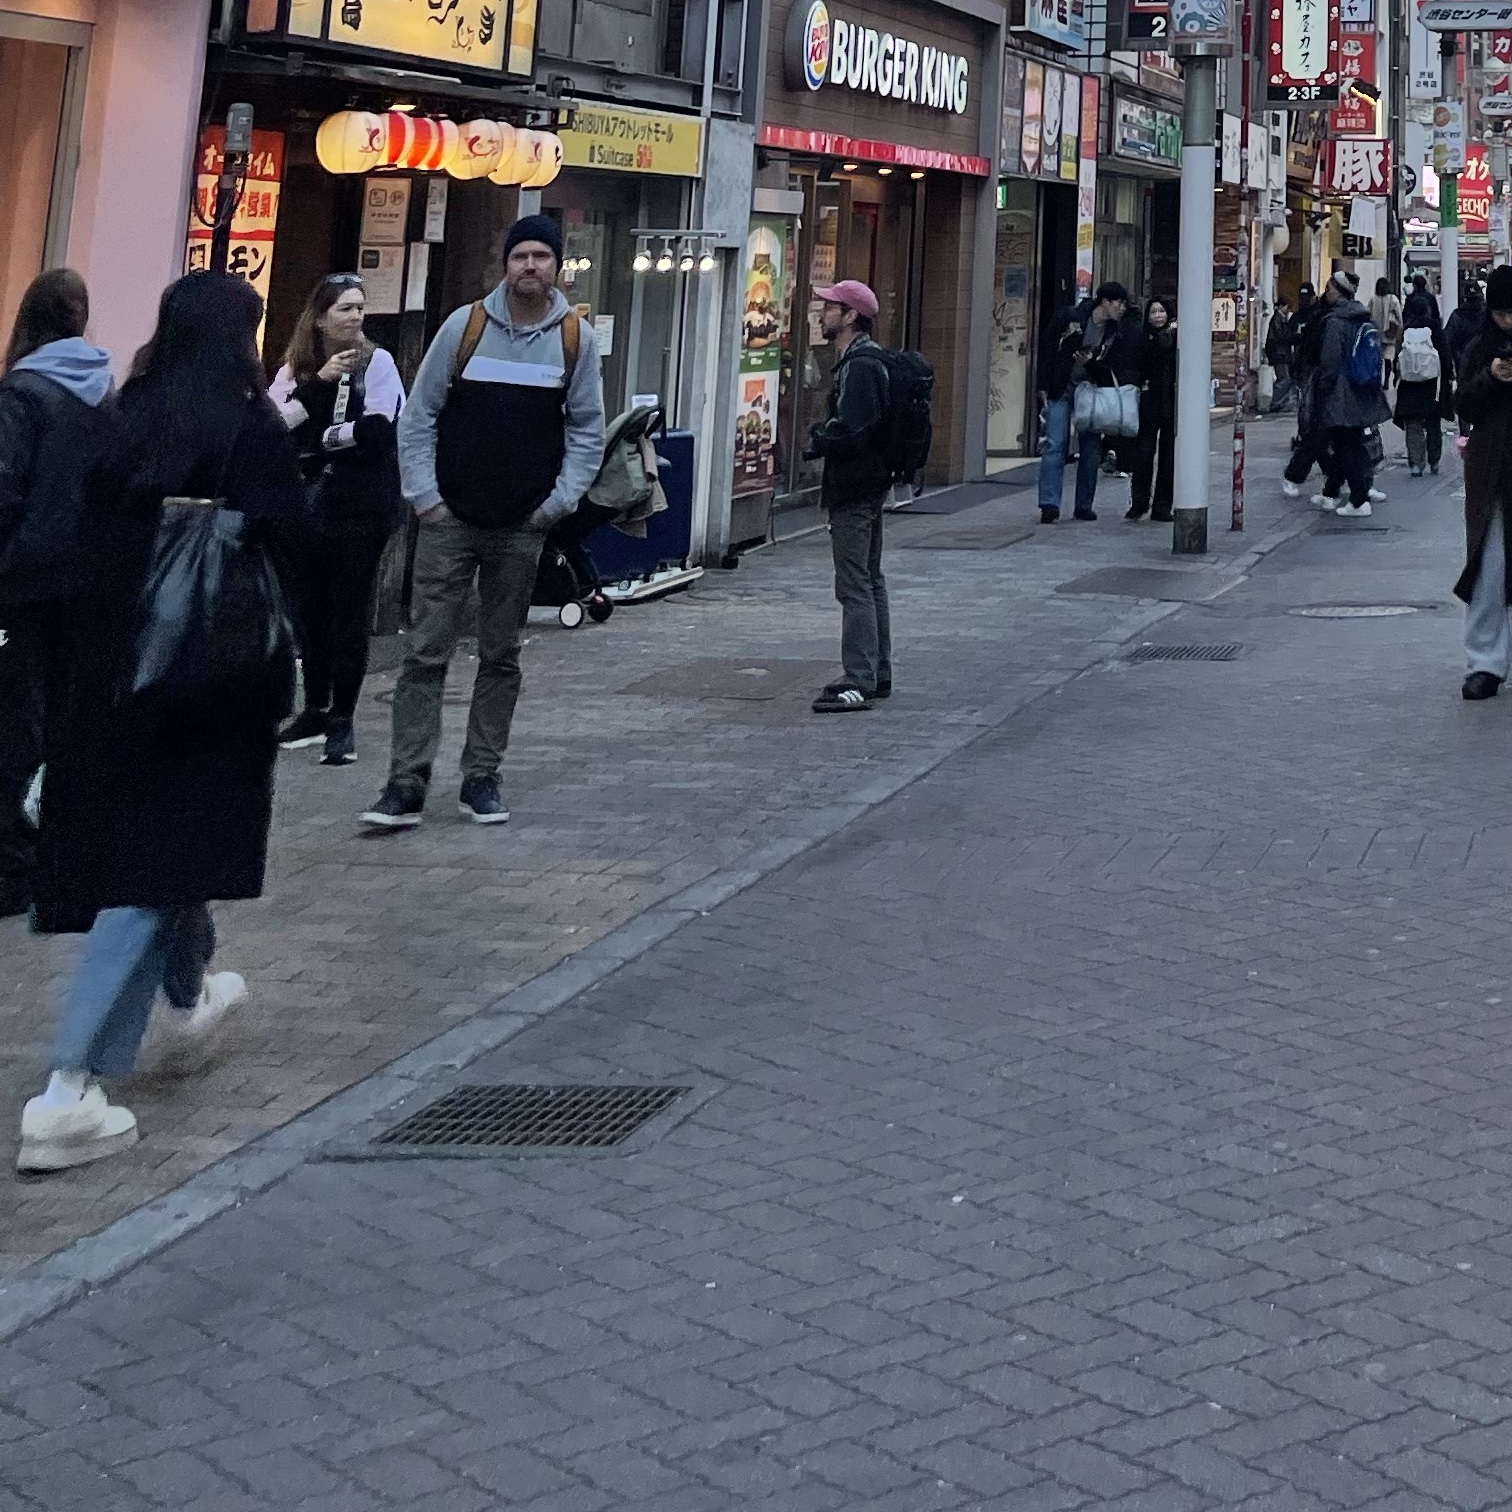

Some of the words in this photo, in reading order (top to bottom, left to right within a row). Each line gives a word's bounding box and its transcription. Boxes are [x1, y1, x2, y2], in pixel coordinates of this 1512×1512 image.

[830, 18, 920, 106] BURGER
[920, 45, 968, 115] KING
[596, 144, 634, 167] Suitcase
[1332, 140, 1385, 192] 豚
